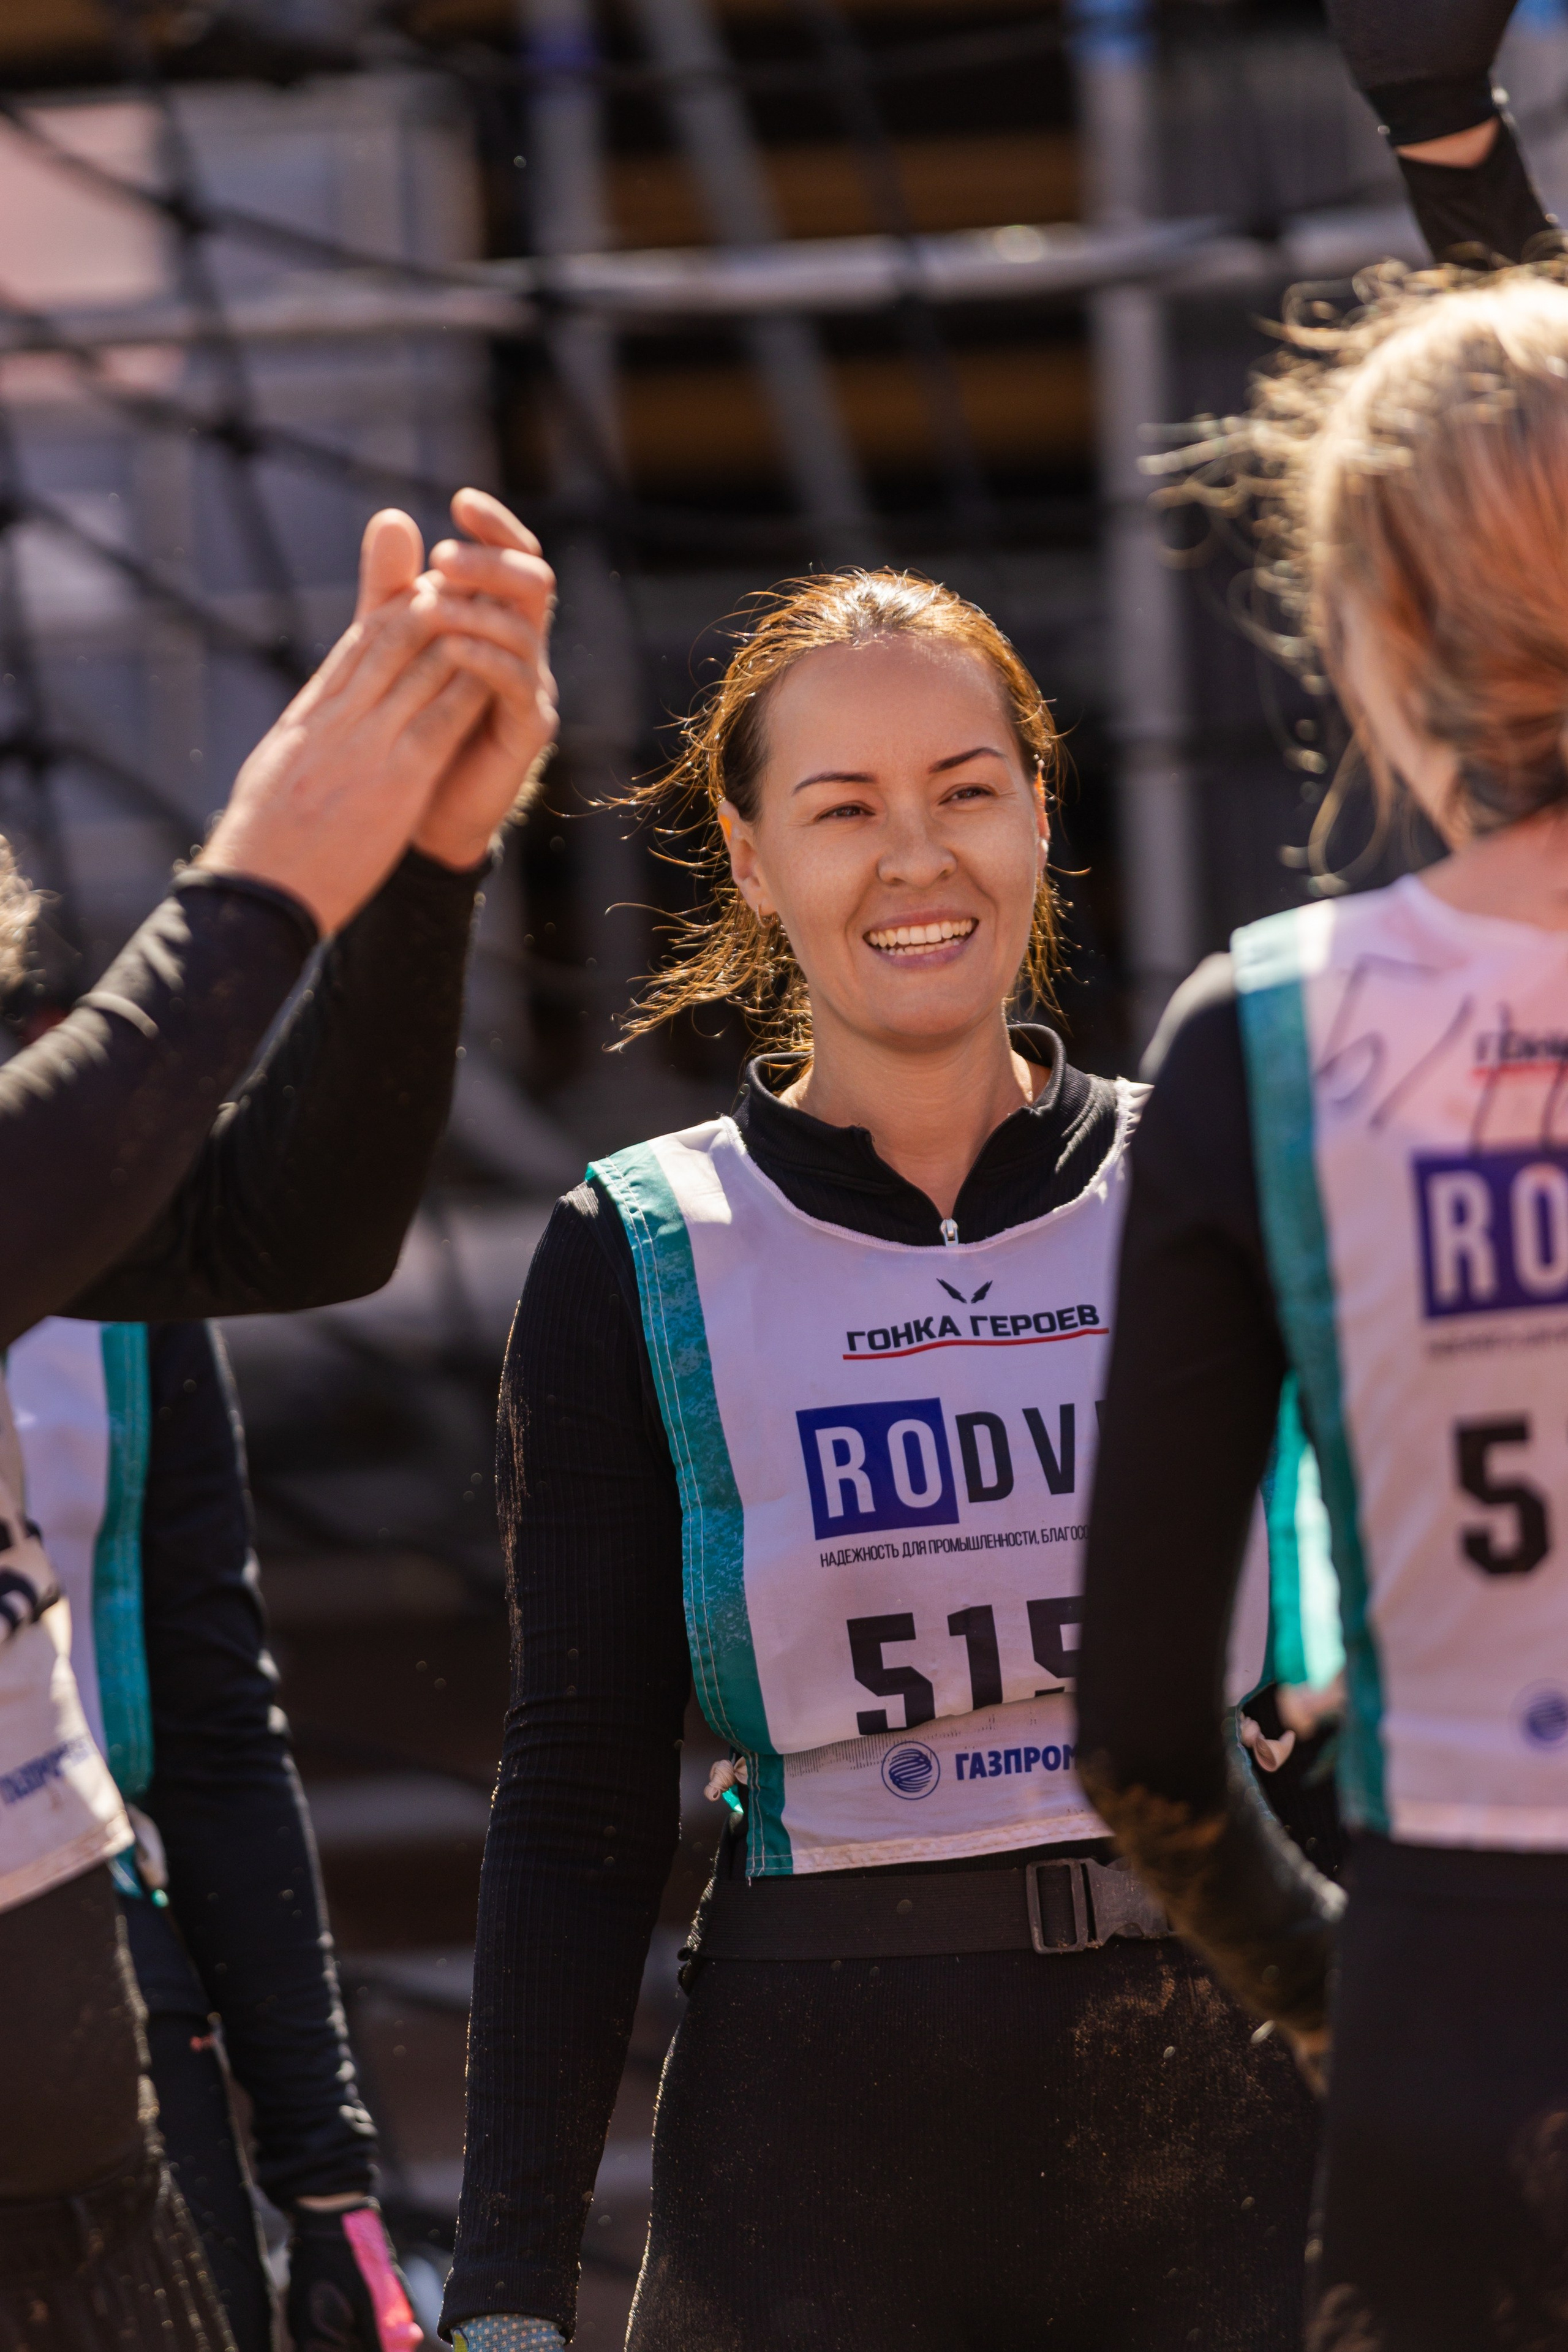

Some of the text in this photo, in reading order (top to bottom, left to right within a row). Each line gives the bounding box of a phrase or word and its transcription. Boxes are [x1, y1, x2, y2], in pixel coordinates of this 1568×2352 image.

[846, 1304, 1100, 1351] ГОНКА ГЕРОЕВ
[815, 1399, 1106, 1518] RODV
[820, 1543, 899, 1568] НАДЕЖНОСТЬ
[902, 1540, 927, 1559] ДЛЯ
[928, 1530, 1040, 1554] ПРОМЫШЛЕННОСТИ,
